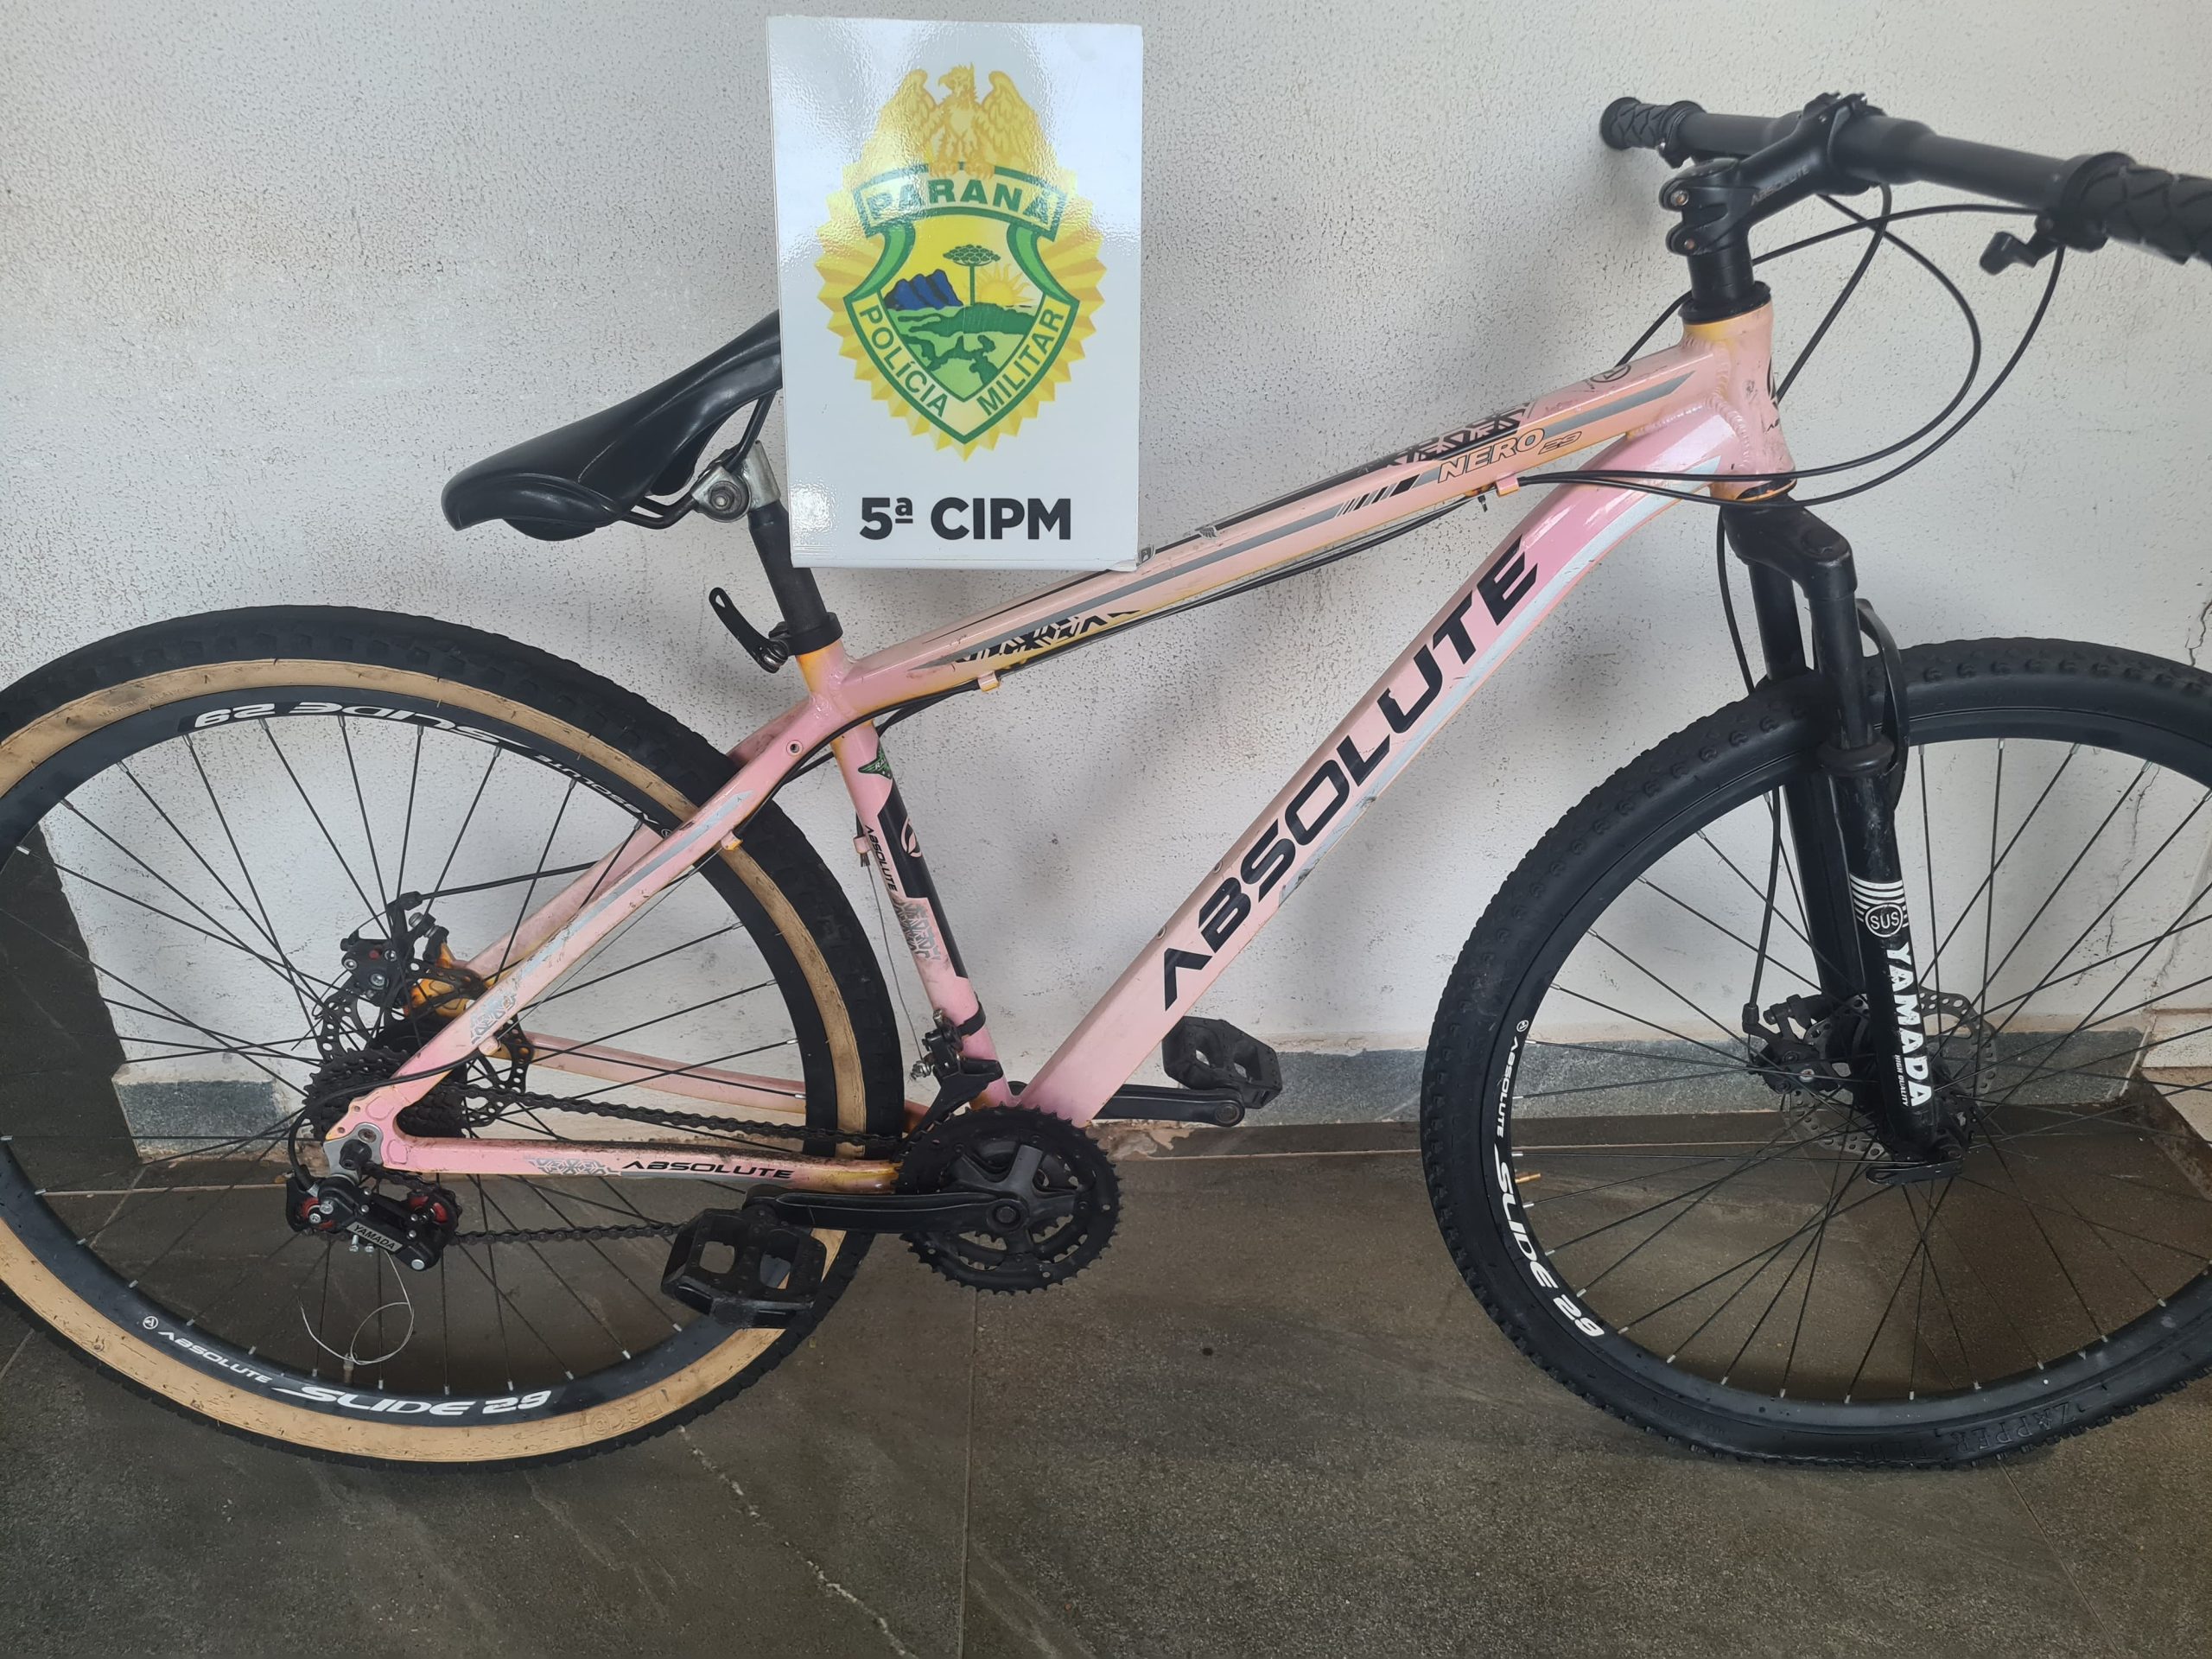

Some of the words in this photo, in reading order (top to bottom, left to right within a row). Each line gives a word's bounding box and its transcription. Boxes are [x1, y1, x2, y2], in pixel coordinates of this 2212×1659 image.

[860, 305, 948, 417] POLÍCIA
[976, 308, 1064, 416] MILITAR
[1437, 428, 1545, 484] NERO
[931, 497, 1071, 540] CIPM
[195, 702, 276, 728] 29
[288, 702, 533, 748] SLIDE
[534, 754, 659, 824] ABSOLUTE
[1165, 533, 1538, 1012] ABSOLUTE
[865, 824, 898, 892] ABSOLUTE
[1870, 911, 1900, 931] SUS
[1886, 942, 1933, 1107] YAMADA
[1497, 1036, 1518, 1138] ABSOLUTE
[1894, 1054, 1903, 1073] HIGH
[1897, 1075, 1909, 1107] QUALITY
[622, 1160, 795, 1179] ABSOLUTE
[353, 1225, 397, 1250] YAMADA
[1494, 1143, 1558, 1289] SLIDE
[1553, 1294, 1605, 1338] 29
[158, 1332, 272, 1383] ABSOLUTE
[270, 1384, 479, 1415] SLIDE
[481, 1389, 551, 1414] 29
